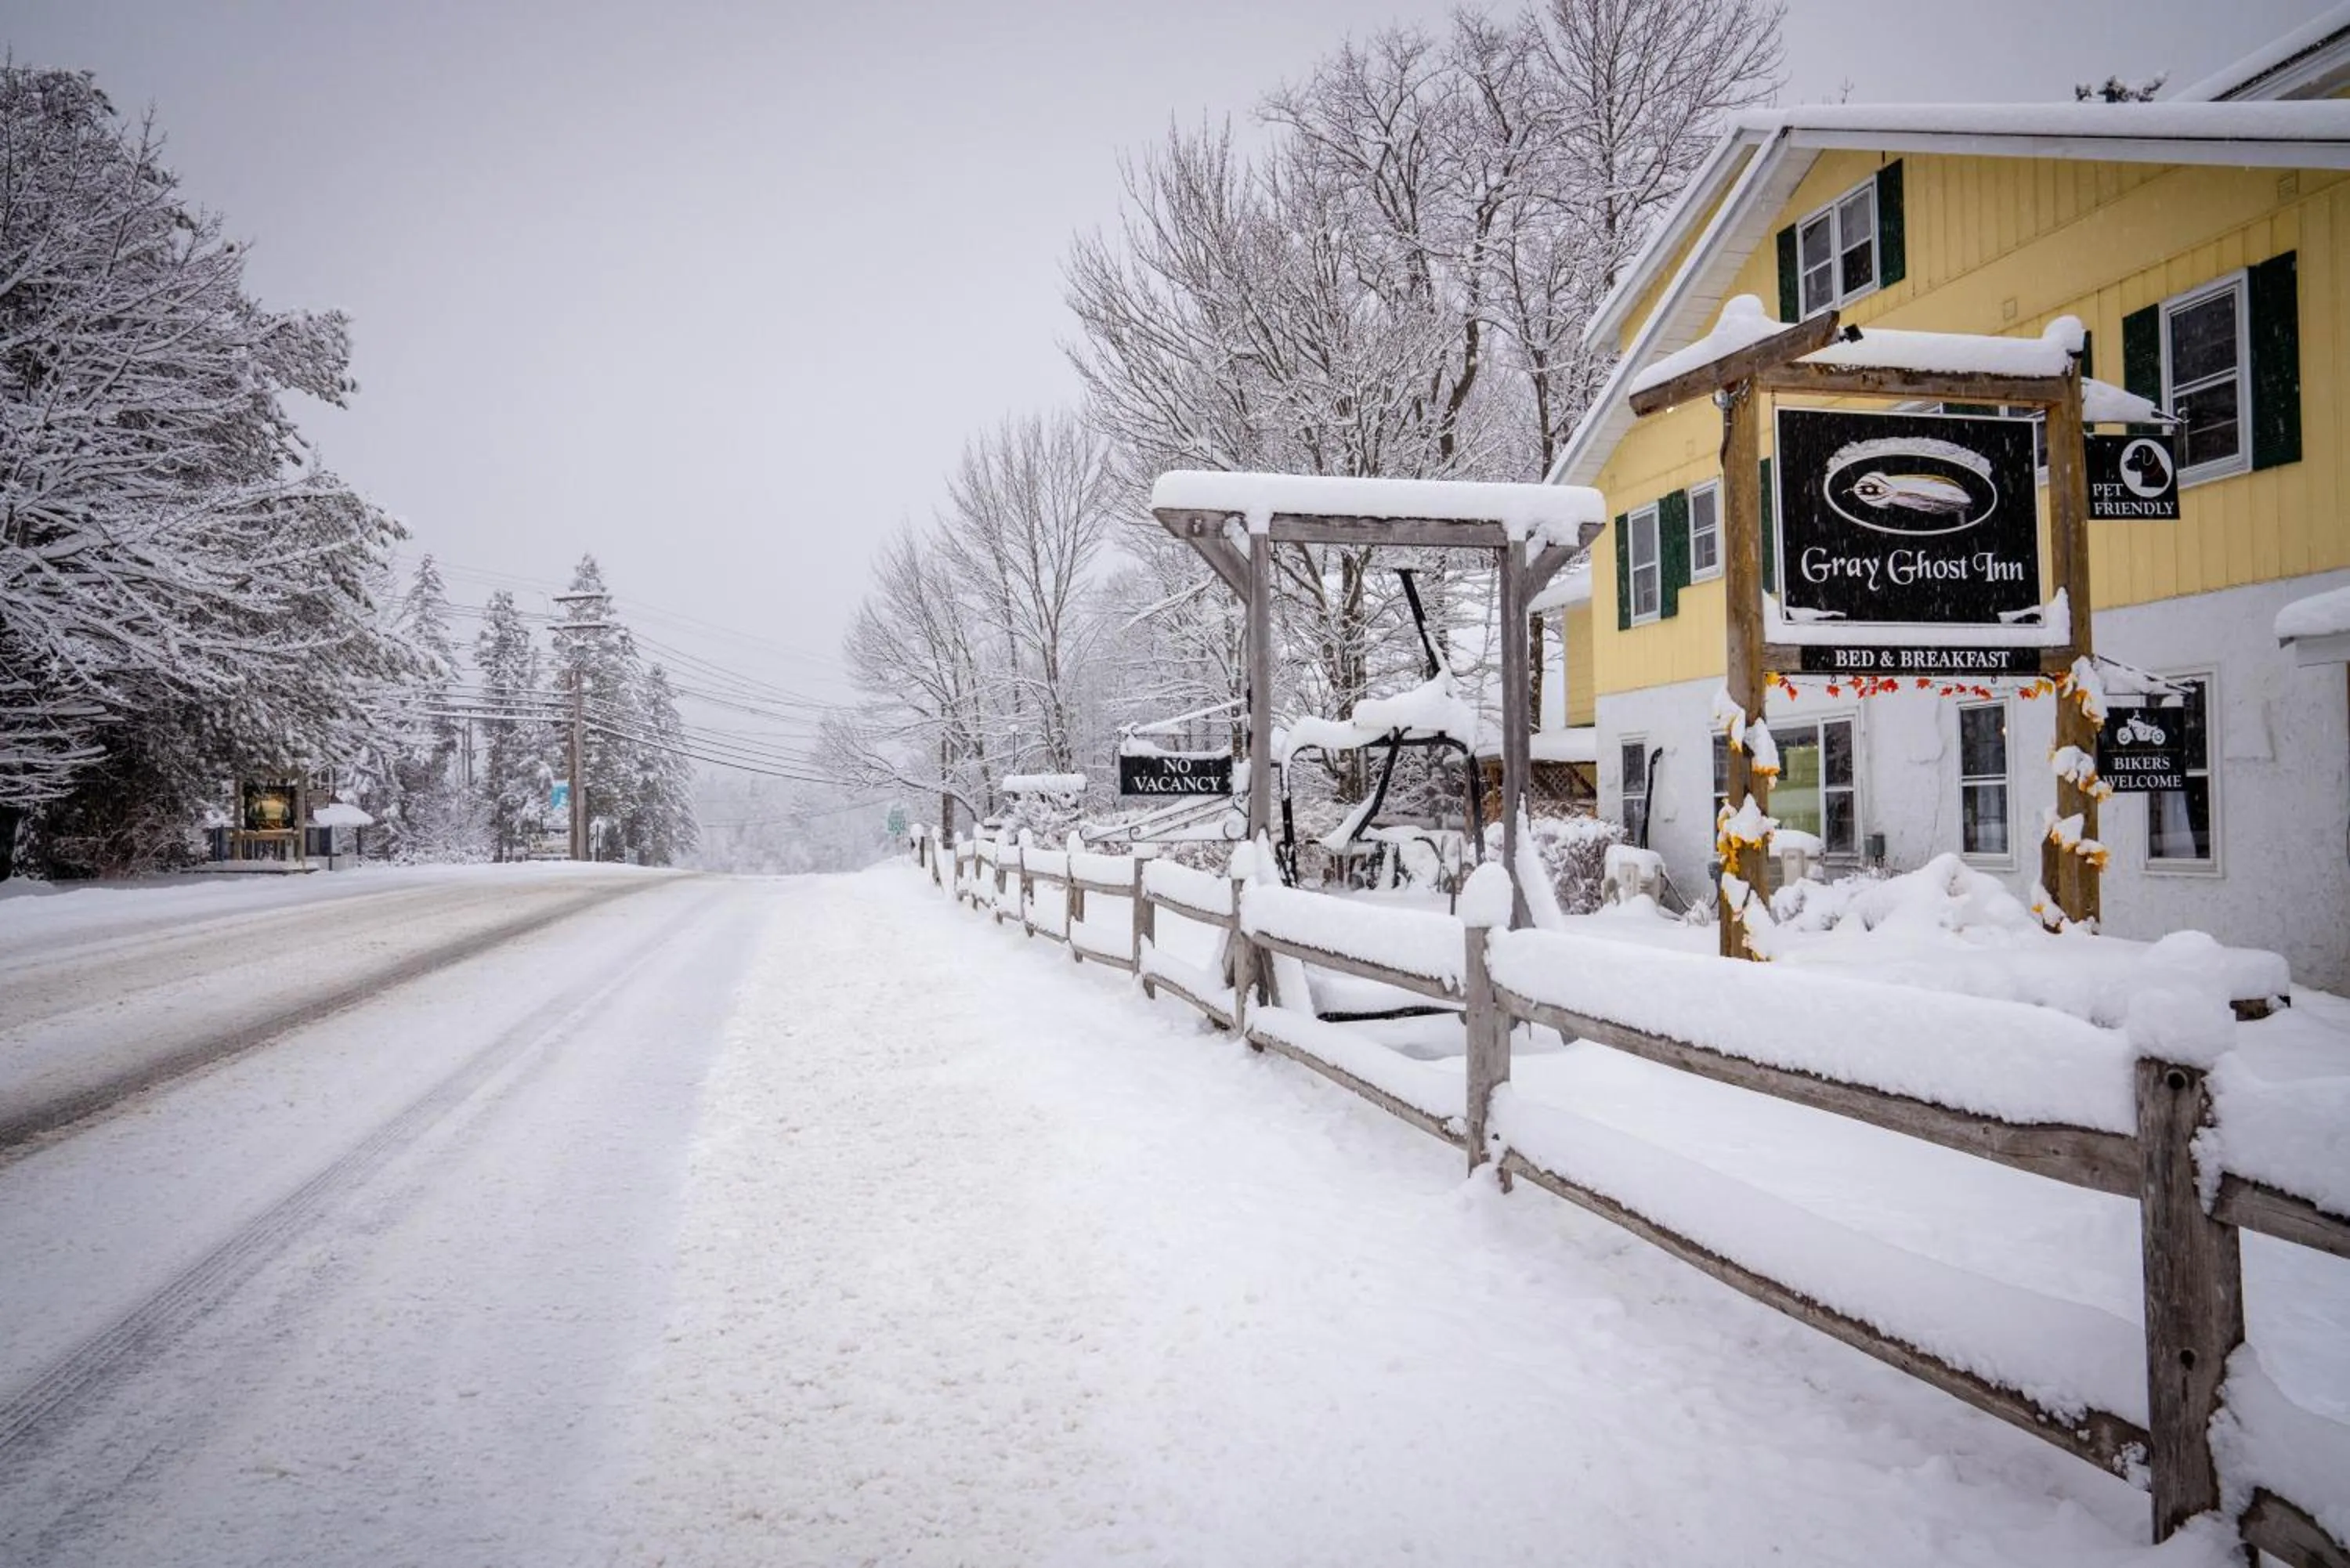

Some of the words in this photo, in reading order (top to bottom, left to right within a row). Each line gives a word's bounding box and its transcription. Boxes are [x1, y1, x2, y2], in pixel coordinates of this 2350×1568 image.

[2092, 483, 2124, 497] PET
[2094, 501, 2175, 515] FRIENDLY
[1801, 547, 1880, 591] Gray
[1887, 549, 1968, 585] Ghost
[1972, 552, 2025, 582] Inn
[1835, 649, 1875, 667] BED
[1880, 650, 1895, 667] &
[1900, 650, 2010, 667] BREAKFAST
[1163, 759, 1191, 773] NO
[2114, 757, 2171, 770] BIKERS
[1133, 776, 1221, 792] VACANCY
[2103, 775, 2182, 788] WELCOME
